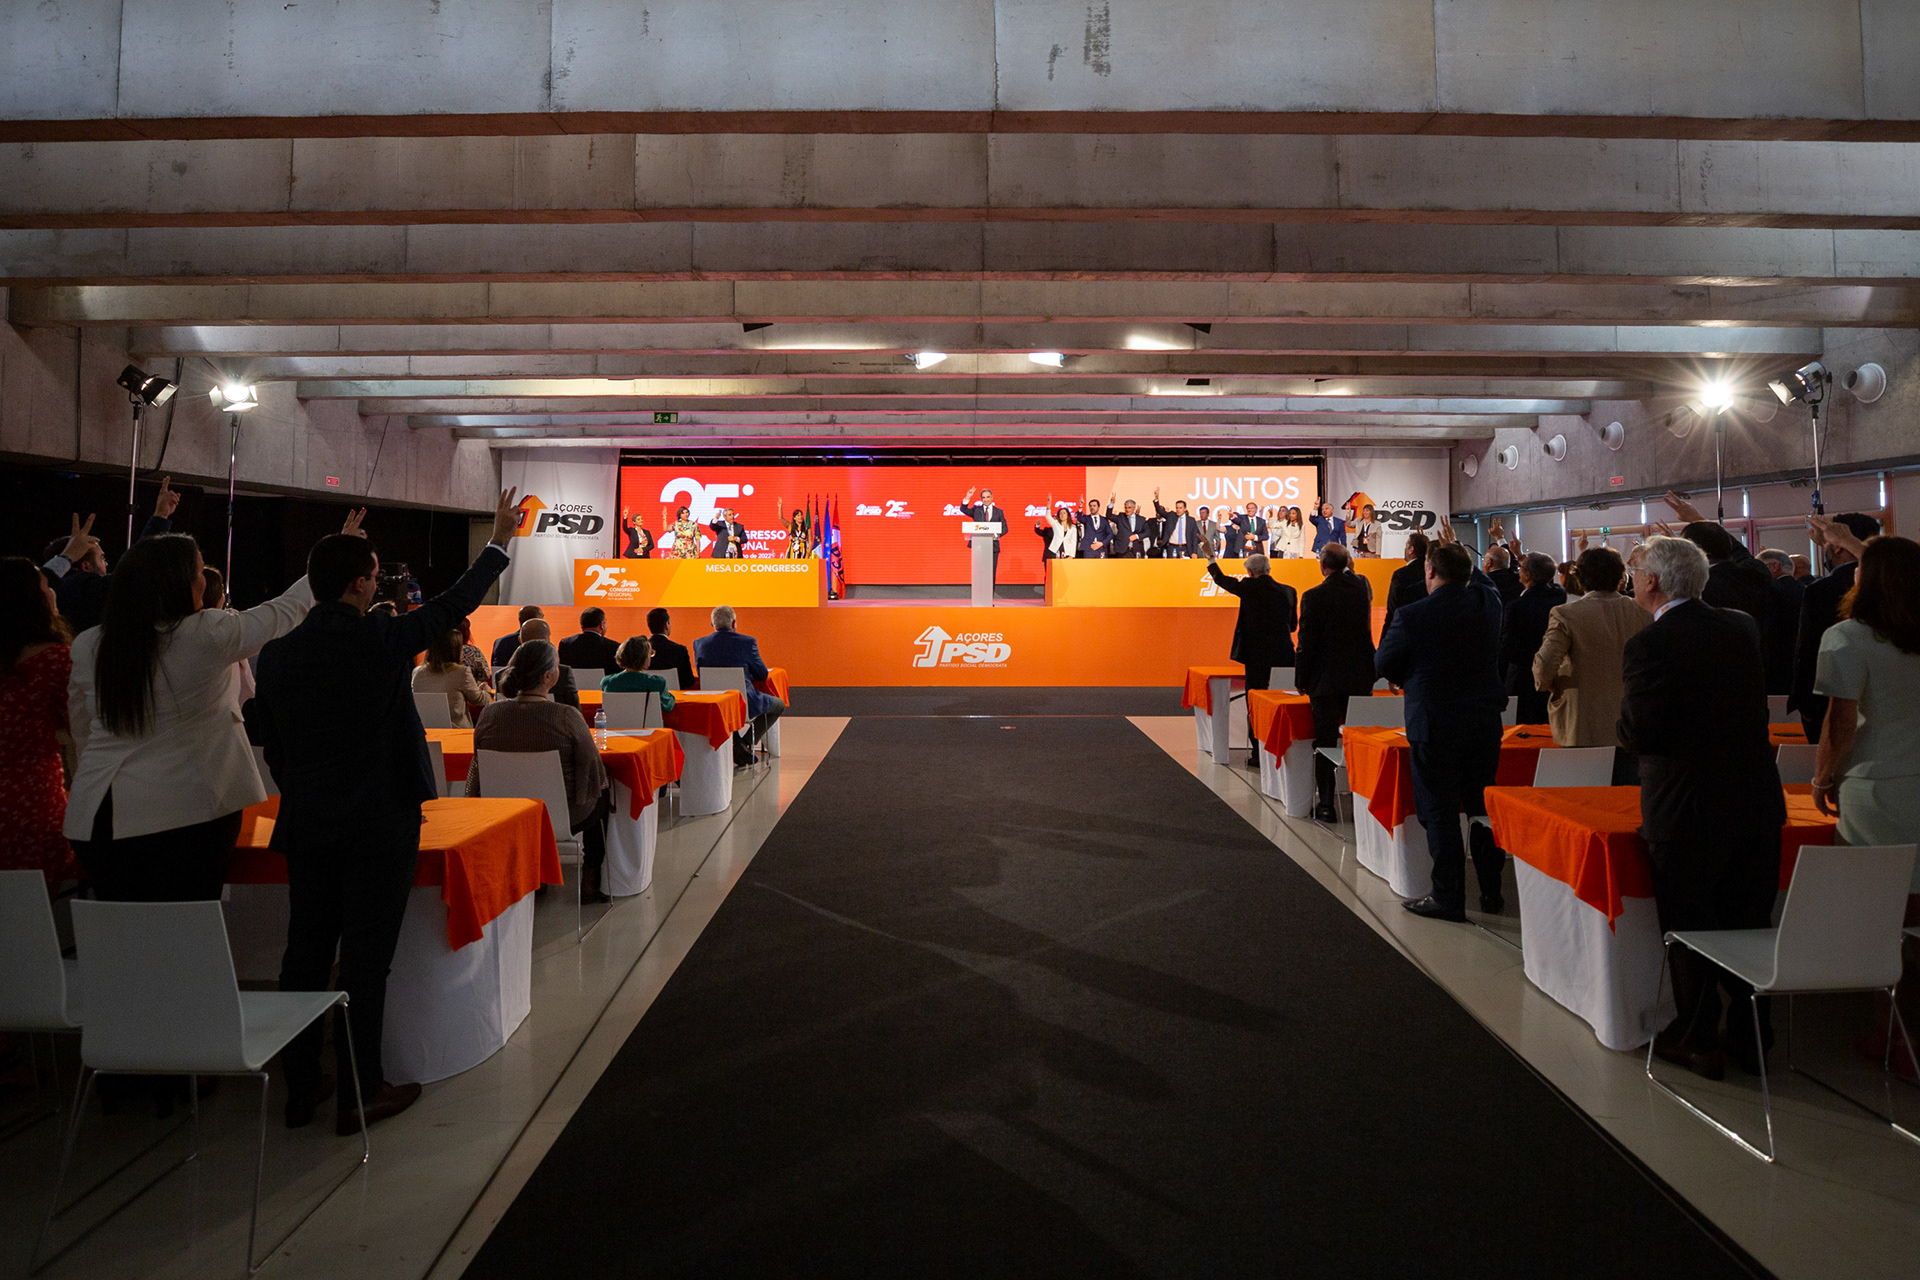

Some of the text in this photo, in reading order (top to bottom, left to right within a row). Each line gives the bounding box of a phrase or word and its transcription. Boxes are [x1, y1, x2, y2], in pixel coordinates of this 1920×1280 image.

[1187, 476, 1300, 500] JUNTOS
[553, 503, 593, 514] AÇORES
[1382, 500, 1424, 509] AÇORES
[535, 513, 604, 535] PSD
[1375, 510, 1436, 530] PSD
[743, 530, 787, 540] GRESSO
[705, 564, 809, 572] MESA DO CONGRESSO
[955, 632, 1004, 643] AÇORES
[940, 643, 1012, 663] PSD
